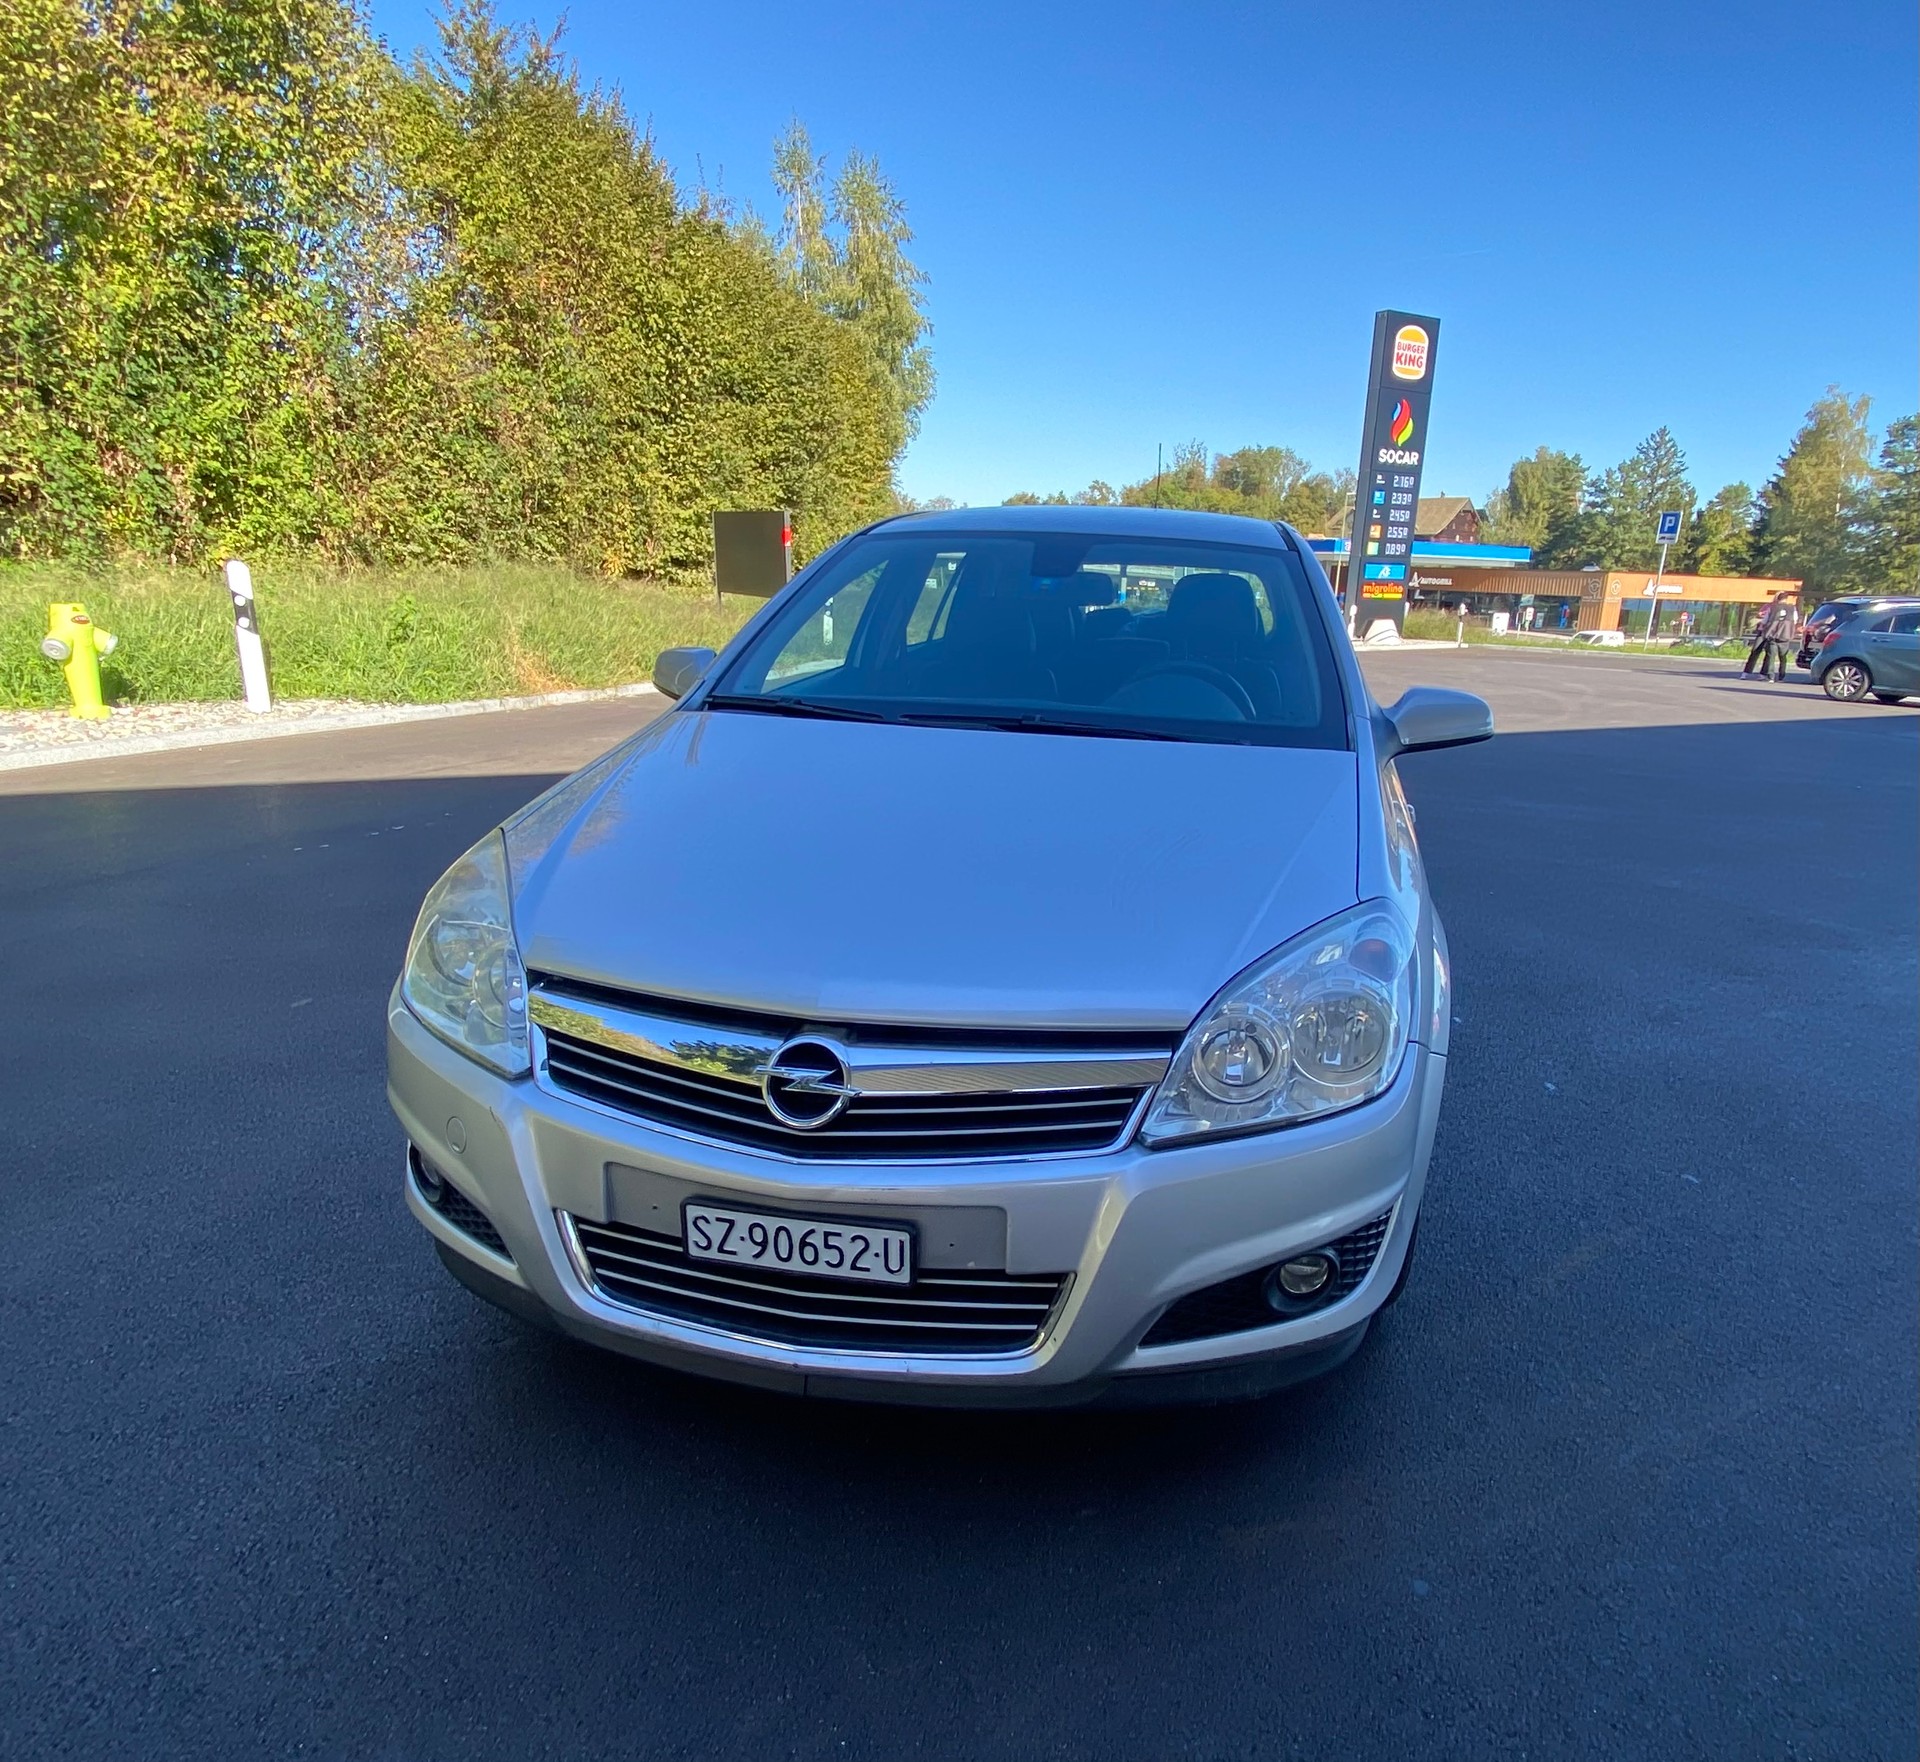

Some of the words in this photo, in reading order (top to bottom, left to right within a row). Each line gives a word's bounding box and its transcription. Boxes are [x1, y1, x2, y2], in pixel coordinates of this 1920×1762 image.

[1397, 342, 1425, 354] BURGER
[1395, 352, 1423, 368] KING
[1378, 449, 1419, 465] SOCAR
[1664, 516, 1675, 532] P
[1363, 582, 1404, 594] migrolino
